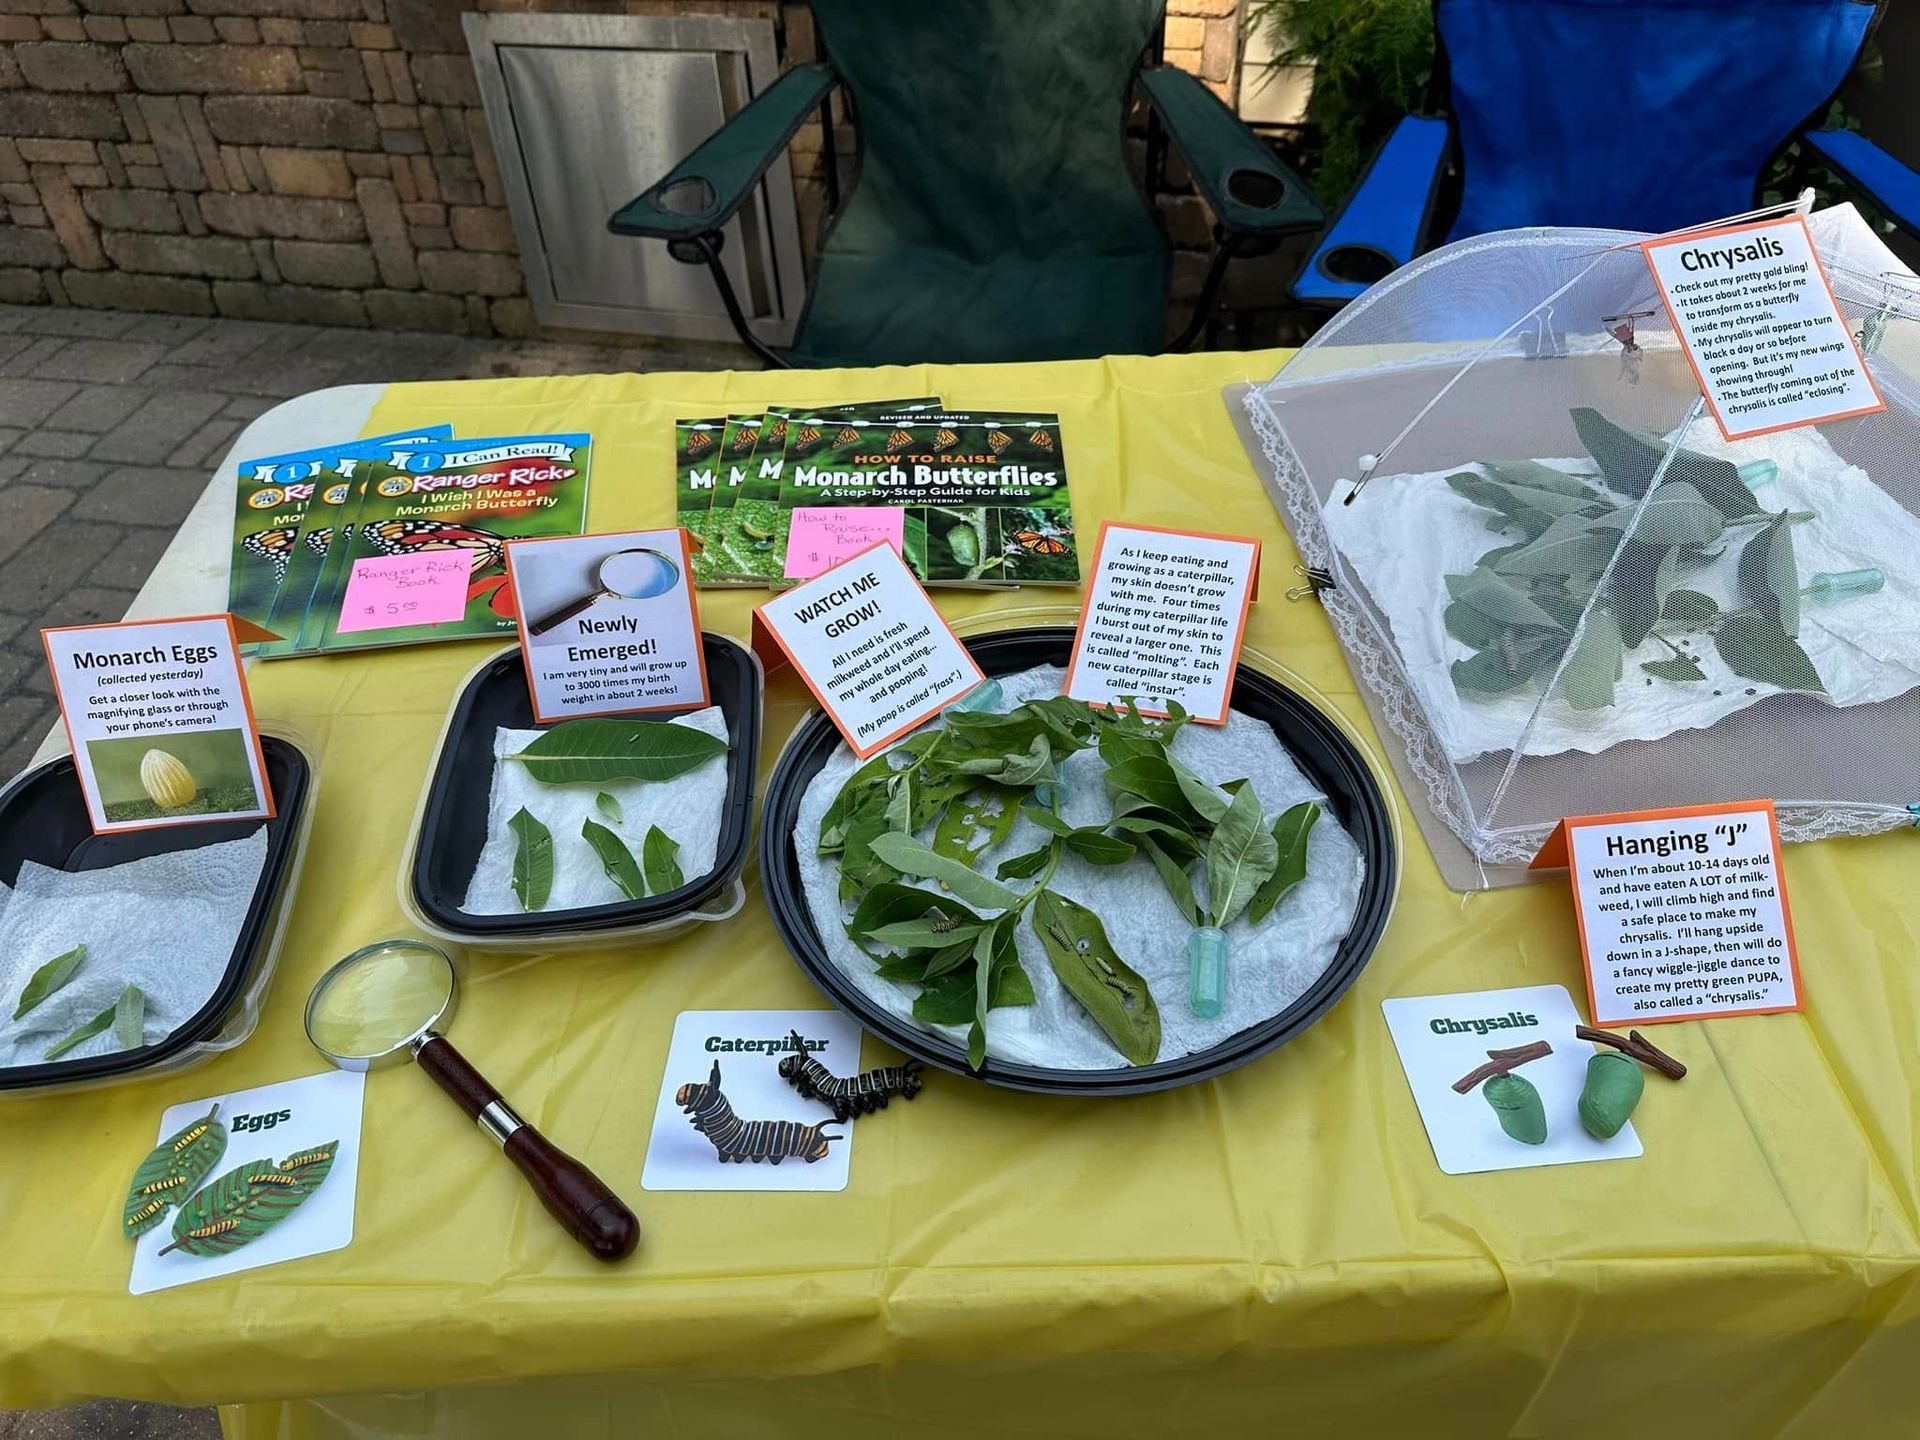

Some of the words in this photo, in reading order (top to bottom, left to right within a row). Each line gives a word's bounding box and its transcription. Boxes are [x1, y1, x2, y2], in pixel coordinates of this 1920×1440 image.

[1680, 236, 1784, 272] Chrysalis
[1674, 280, 1702, 294] Check
[1702, 278, 1719, 289] out
[1719, 276, 1734, 286] my
[1734, 271, 1761, 285] pretty
[1762, 265, 1782, 280] gold
[1783, 261, 1809, 274] bling!
[1679, 298, 1688, 307] It
[1688, 294, 1714, 306] takes
[1714, 288, 1742, 301] about
[1742, 286, 1749, 295] 2
[1749, 282, 1777, 294] weeks
[1778, 279, 1791, 291] for
[1792, 278, 1807, 287] me
[1685, 312, 1696, 321] to
[1696, 303, 1742, 319] transform
[1743, 301, 1754, 310] as
[1761, 292, 1799, 306] butterfly
[422, 456, 430, 469] 1
[452, 456, 458, 465] I
[459, 452, 500, 464] Can
[507, 445, 558, 455] Read!
[854, 455, 902, 464] HOW
[908, 455, 934, 464] TO
[941, 454, 997, 464] RAISE
[412, 471, 505, 493] Ranger
[509, 465, 565, 486] Rick
[794, 465, 911, 487] Monarch
[914, 464, 1057, 487] Butterflies
[422, 494, 427, 504] I
[430, 492, 473, 503] Wish
[476, 491, 482, 500] I
[485, 489, 522, 499] Was
[525, 488, 537, 497] a
[820, 488, 832, 497] A
[834, 487, 927, 498] Step-by-Step
[930, 487, 973, 496] Guide
[976, 487, 997, 496] for
[1000, 487, 1031, 496] Kids
[396, 501, 473, 517] Monarch
[476, 496, 559, 511] Butterfly
[798, 512, 827, 523] How
[832, 512, 847, 521] to
[836, 534, 875, 545] Book
[1119, 547, 1134, 557] As
[1136, 548, 1141, 558] I
[1142, 549, 1168, 563] keep
[1170, 555, 1205, 568] eating
[1206, 559, 1229, 569] and
[357, 566, 422, 582] Ranger
[426, 560, 465, 573] Rick
[1107, 561, 1152, 576] growing
[1153, 567, 1165, 576] as
[1167, 569, 1175, 577] a
[1176, 570, 1234, 586] caterpillar,
[395, 576, 441, 589] Book
[1111, 576, 1129, 587] my
[1129, 577, 1152, 588] skin
[1154, 580, 1195, 594] doesn’t
[1196, 587, 1226, 597] grow
[793, 586, 853, 624] WATCH
[851, 572, 880, 595] ME
[578, 615, 640, 635] Newly
[824, 599, 882, 638] GROW!
[567, 638, 657, 662] Emerged!
[831, 654, 846, 669] All
[844, 651, 852, 661] I
[850, 638, 876, 658] need
[873, 635, 884, 644] is
[882, 621, 908, 639] fresh
[72, 645, 167, 670] Monarch
[170, 644, 218, 665] Eggs
[826, 658, 872, 690] milkweed
[871, 647, 891, 665] and
[888, 640, 903, 654] I’ll
[902, 625, 931, 647] spend
[97, 671, 147, 687] (collected
[149, 667, 203, 683] yesterday)
[542, 672, 547, 680] I
[548, 672, 565, 680] am
[565, 669, 588, 679] very
[588, 666, 608, 676] tiny
[609, 663, 628, 674] and
[629, 662, 647, 672] will
[648, 661, 673, 672] grow
[674, 660, 687, 670] up
[838, 688, 855, 702] my
[854, 672, 884, 692] whole
[883, 661, 902, 676] day
[901, 645, 937, 666] eating...
[564, 683, 576, 692] to
[576, 679, 601, 690] 3000
[601, 678, 629, 688] times
[630, 676, 646, 686] my
[646, 672, 671, 683] birth
[869, 686, 888, 703] and
[887, 663, 928, 694] pooping!
[1105, 677, 1139, 690] called
[1140, 681, 1185, 698] “instar”.
[88, 695, 109, 705] Get
[110, 695, 117, 703] a
[119, 692, 150, 703] closer
[151, 689, 176, 700] look
[176, 687, 201, 698] with
[202, 686, 220, 696] the
[560, 693, 594, 705] weight
[595, 692, 606, 701] in
[607, 689, 635, 700] about
[636, 688, 644, 697] 2
[644, 684, 678, 696] weeks!
[857, 721, 875, 738] (My
[875, 709, 897, 728] poop
[896, 704, 906, 713] is
[905, 687, 930, 708] called
[928, 668, 962, 694] “frass”.)
[87, 706, 146, 720] magnifying
[146, 704, 173, 717] glass
[173, 704, 186, 712] or
[186, 699, 229, 712] through
[105, 723, 130, 734] your
[132, 717, 173, 732] phone’s
[174, 713, 217, 727] camera!
[1606, 829, 1709, 857] Hanging
[1714, 822, 1747, 846] “J”
[1592, 867, 1627, 879] When
[1629, 864, 1649, 876] I’m
[1650, 862, 1686, 874] about
[1687, 858, 1720, 871] 10-14
[1722, 856, 1749, 869] days
[1750, 853, 1770, 866] old
[1599, 882, 1621, 895] and
[1622, 882, 1651, 893] have
[1653, 879, 1687, 891] eaten
[1688, 877, 1699, 888] A
[1700, 874, 1722, 887] LOT
[1724, 872, 1737, 885] of
[1739, 870, 1768, 883] milk-
[1430, 1012, 1538, 1035] Chrysalis
[231, 1108, 291, 1133] Eggs
